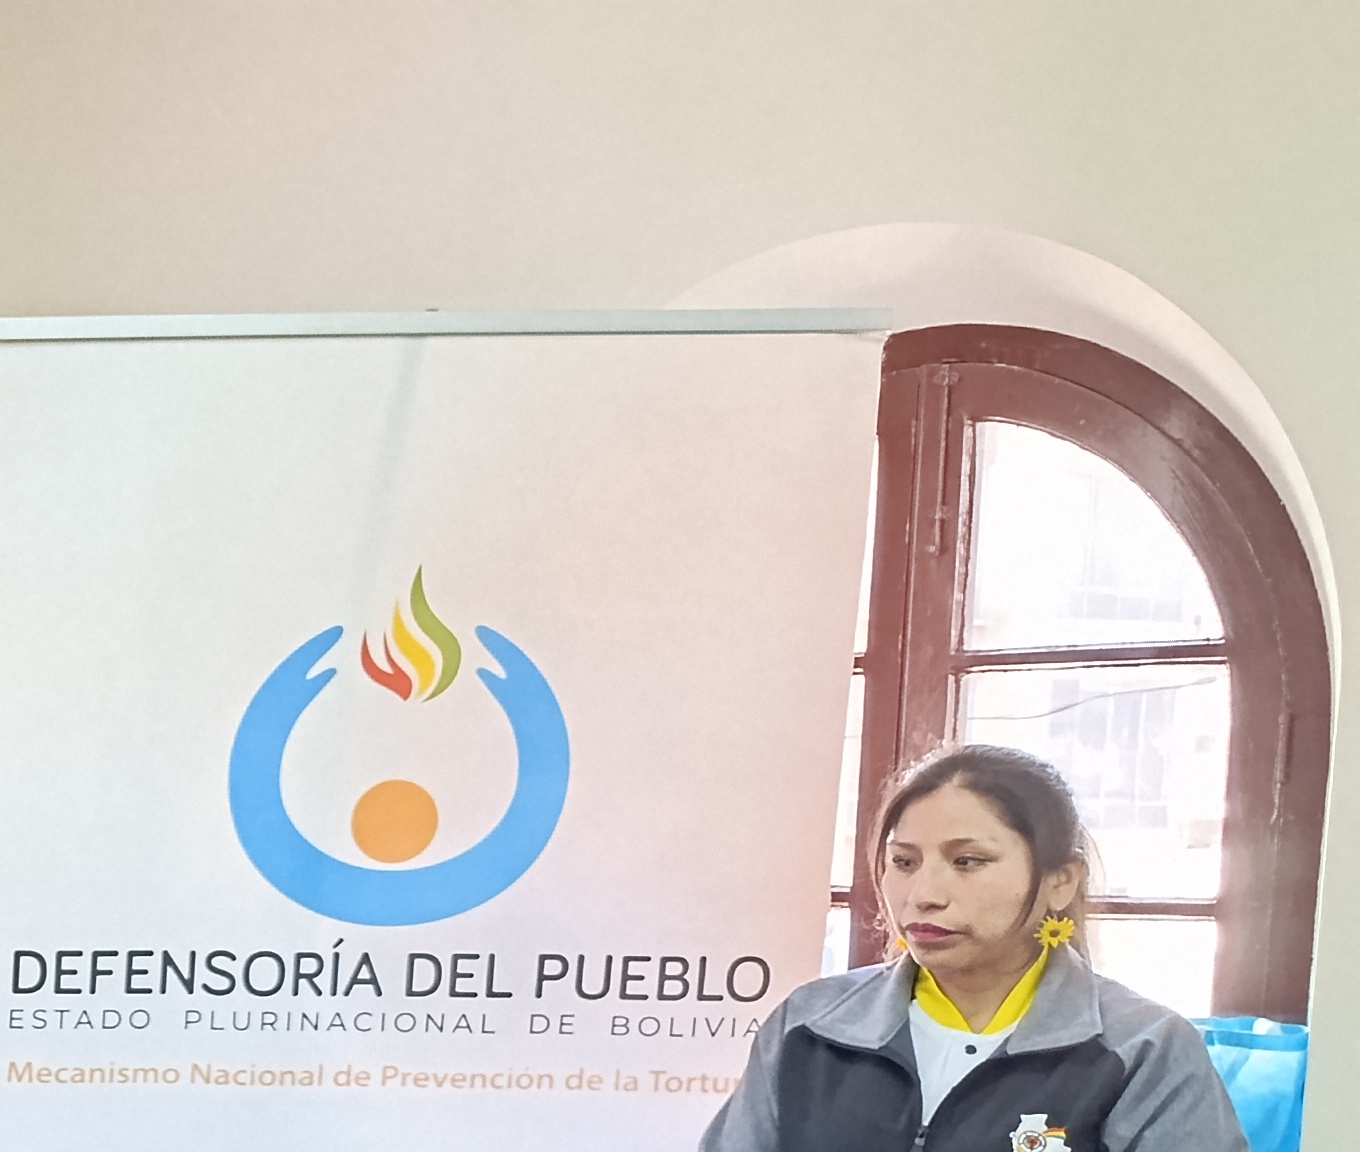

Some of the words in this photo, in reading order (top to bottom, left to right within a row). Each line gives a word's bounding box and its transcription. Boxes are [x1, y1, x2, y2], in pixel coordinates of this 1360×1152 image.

[11, 937, 383, 998] DEFENSORÍA
[405, 952, 514, 999] DEL
[535, 953, 771, 1003] PUEBLO
[8, 1008, 151, 1030] ESTADO
[184, 1009, 496, 1035] PLURINACIONAL
[529, 1013, 576, 1035] DE
[610, 1015, 760, 1039] BOLIVIA
[7, 1061, 181, 1085] Mecanismo
[190, 1062, 324, 1087] Nacional
[332, 1064, 372, 1088] de
[380, 1065, 555, 1091] Prevención
[564, 1067, 604, 1092] de
[613, 1068, 640, 1092] la
